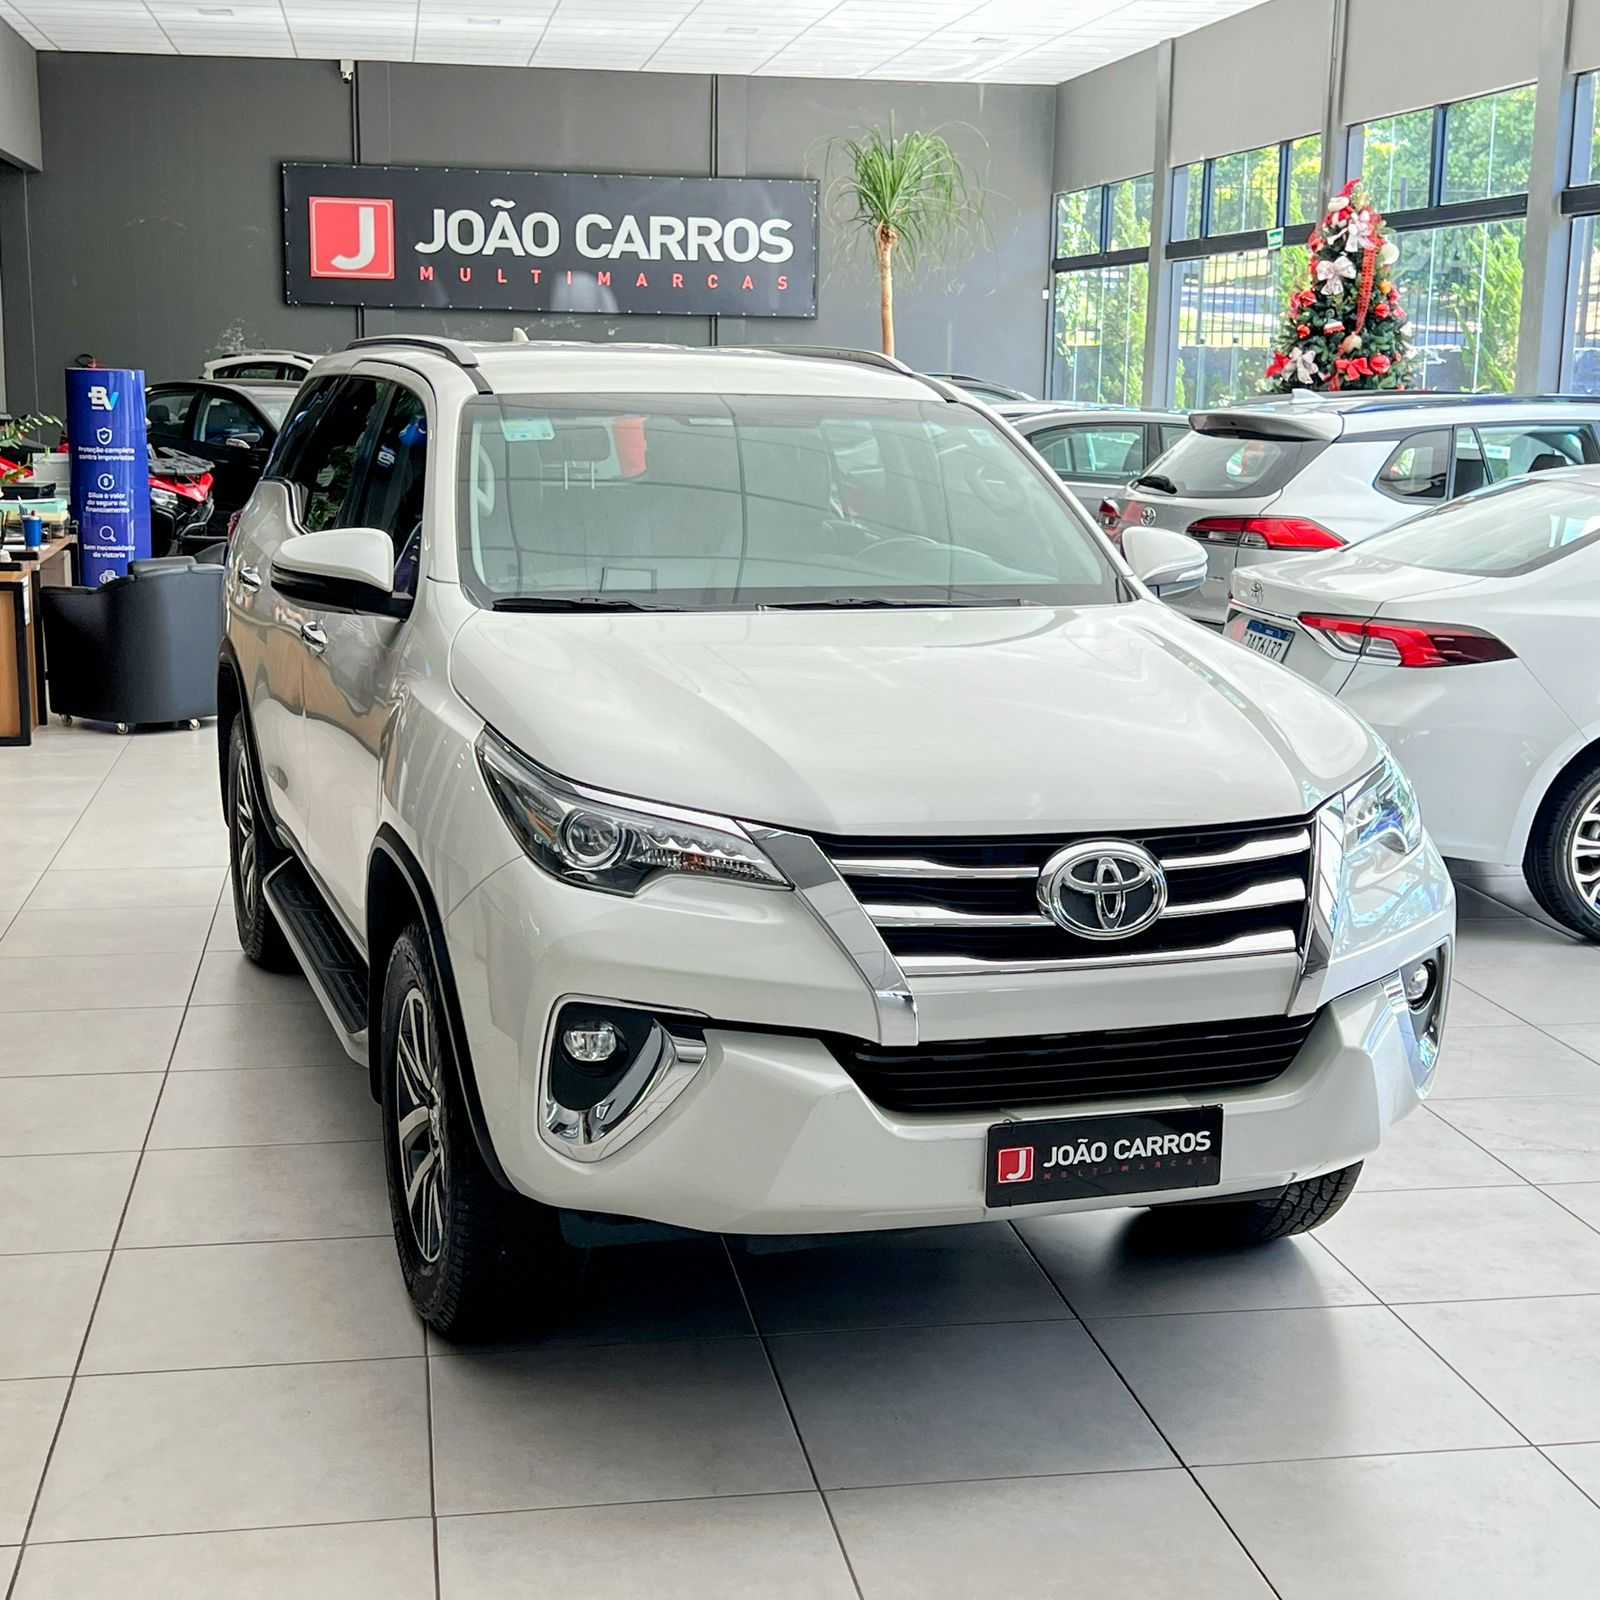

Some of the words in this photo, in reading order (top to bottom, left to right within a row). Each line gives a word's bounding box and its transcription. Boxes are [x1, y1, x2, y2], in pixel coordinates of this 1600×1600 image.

[330, 206, 375, 270] J
[414, 198, 560, 257] JOÃO
[575, 213, 795, 263] CARROS
[420, 266, 789, 291] MULTIMARCAS
[88, 386, 119, 411] BV
[1006, 1150, 1027, 1180] J
[1043, 1138, 1107, 1168] JOÃO
[1113, 1130, 1211, 1160] CARROS
